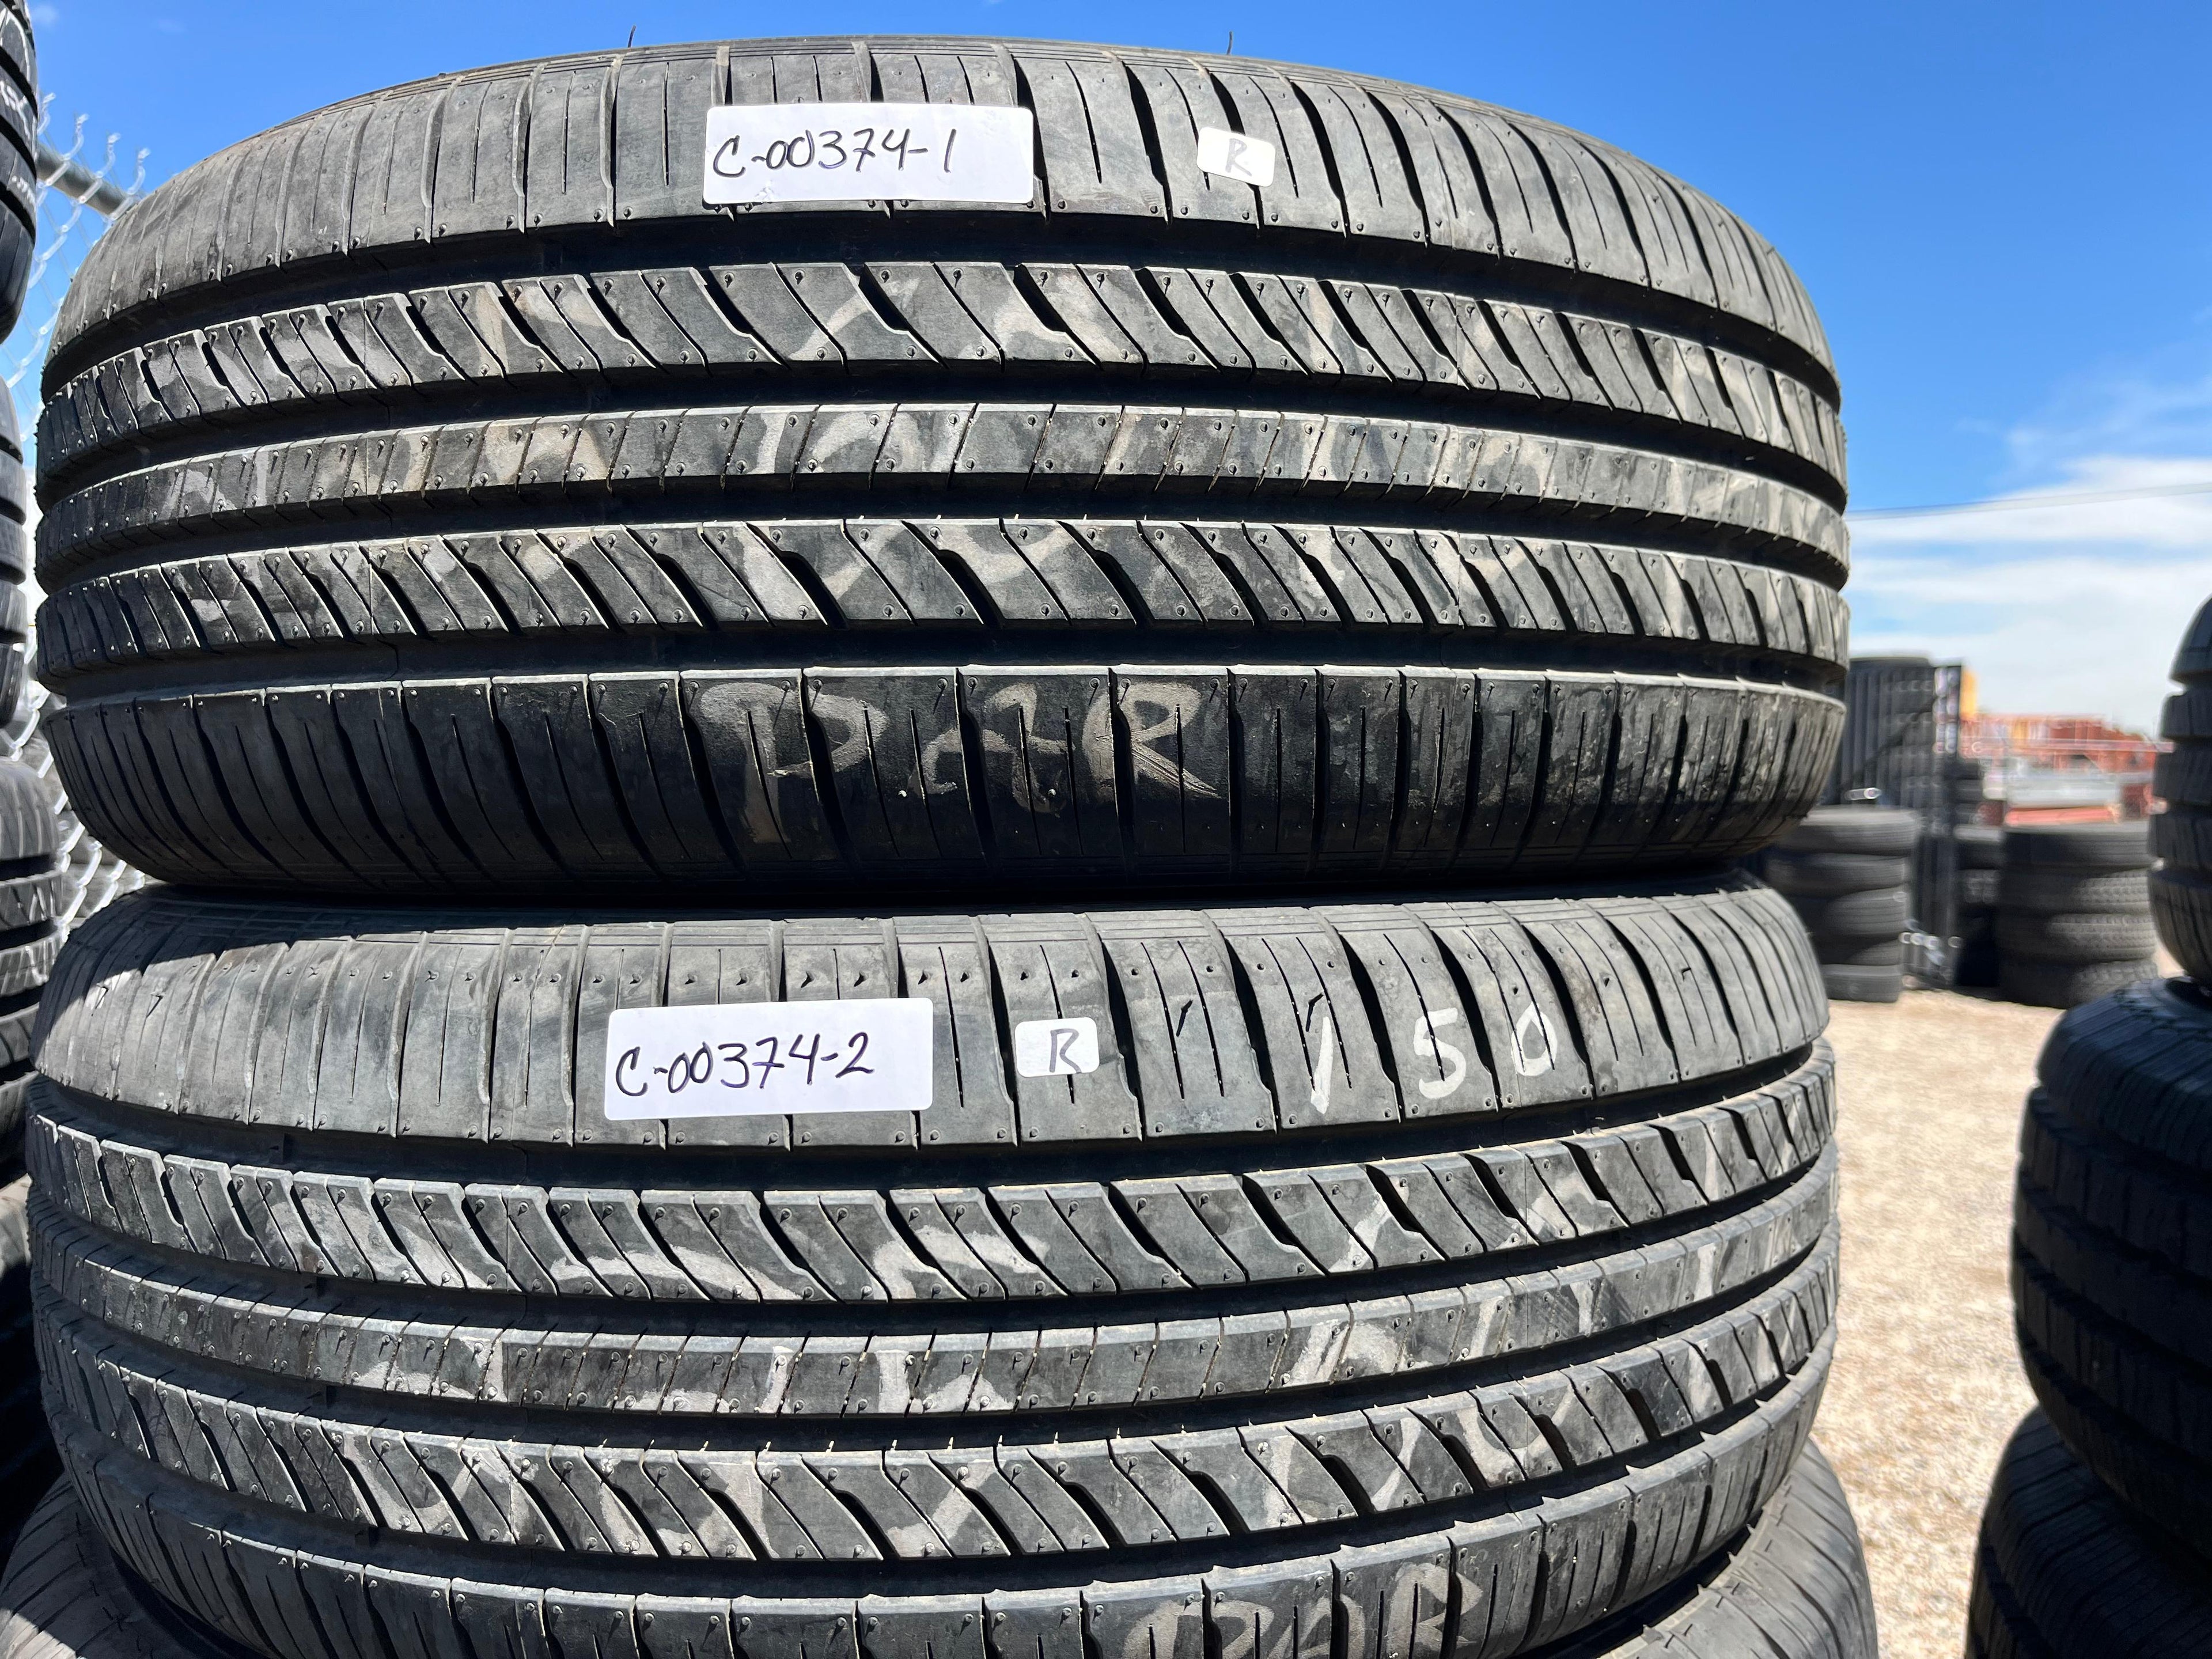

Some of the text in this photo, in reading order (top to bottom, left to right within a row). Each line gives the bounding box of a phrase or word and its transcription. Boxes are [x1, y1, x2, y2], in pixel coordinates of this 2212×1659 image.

[713, 128, 957, 178] C-00374-1
[1225, 138, 1252, 177] R
[616, 1032, 875, 1096] C-00374-2
[1050, 1028, 1082, 1073] R
